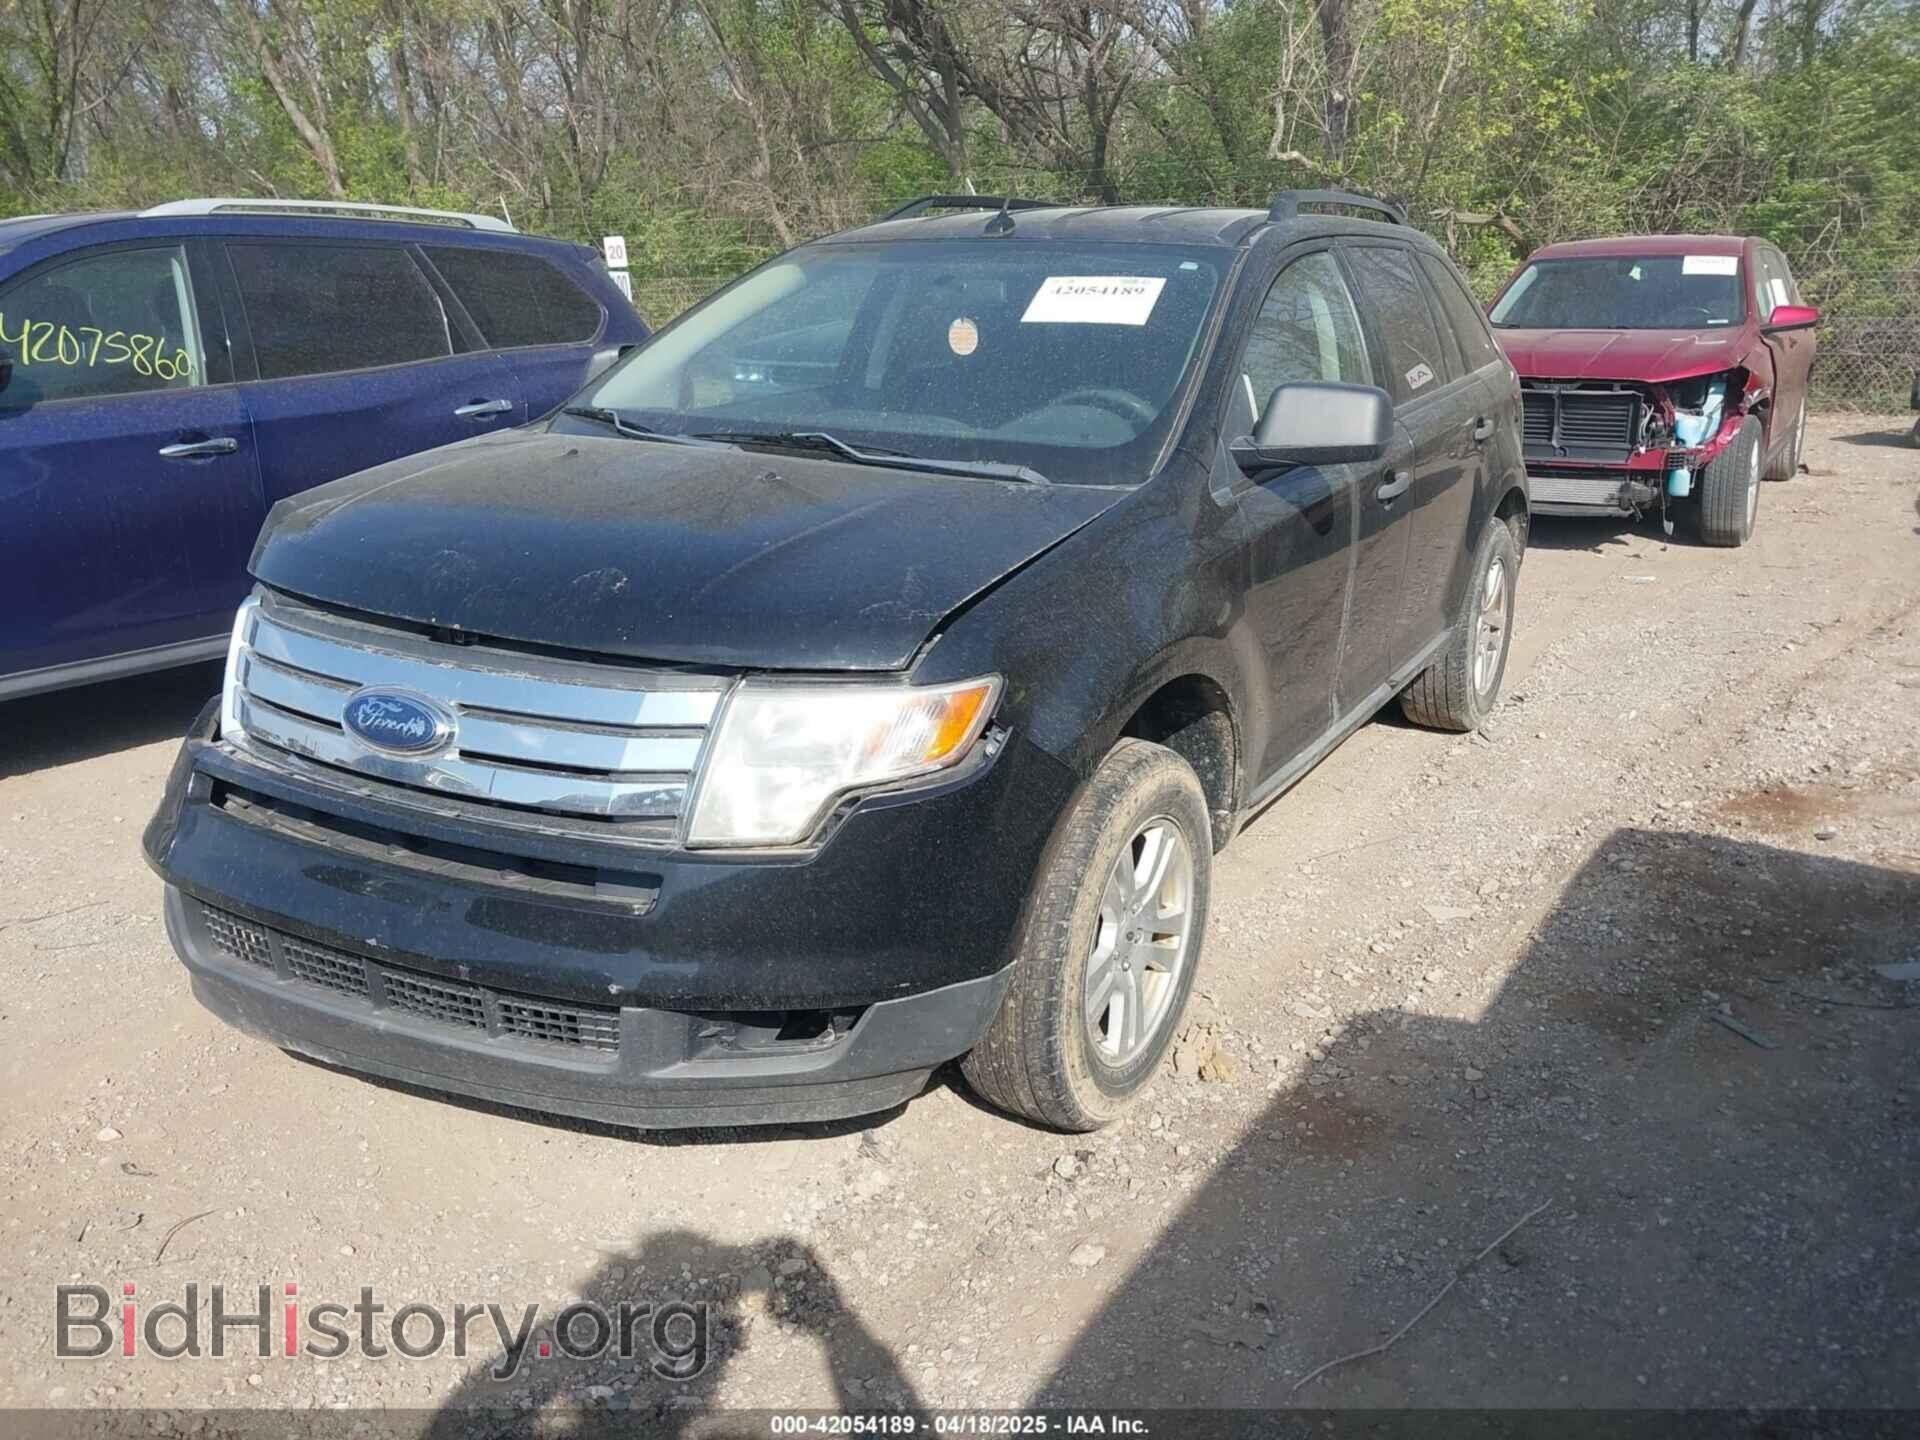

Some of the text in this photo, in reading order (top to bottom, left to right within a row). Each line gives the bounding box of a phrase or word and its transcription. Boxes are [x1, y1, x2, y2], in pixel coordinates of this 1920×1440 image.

[608, 245, 623, 260] 20
[1050, 285, 1145, 296] 42054189
[0, 312, 192, 380] 42075860
